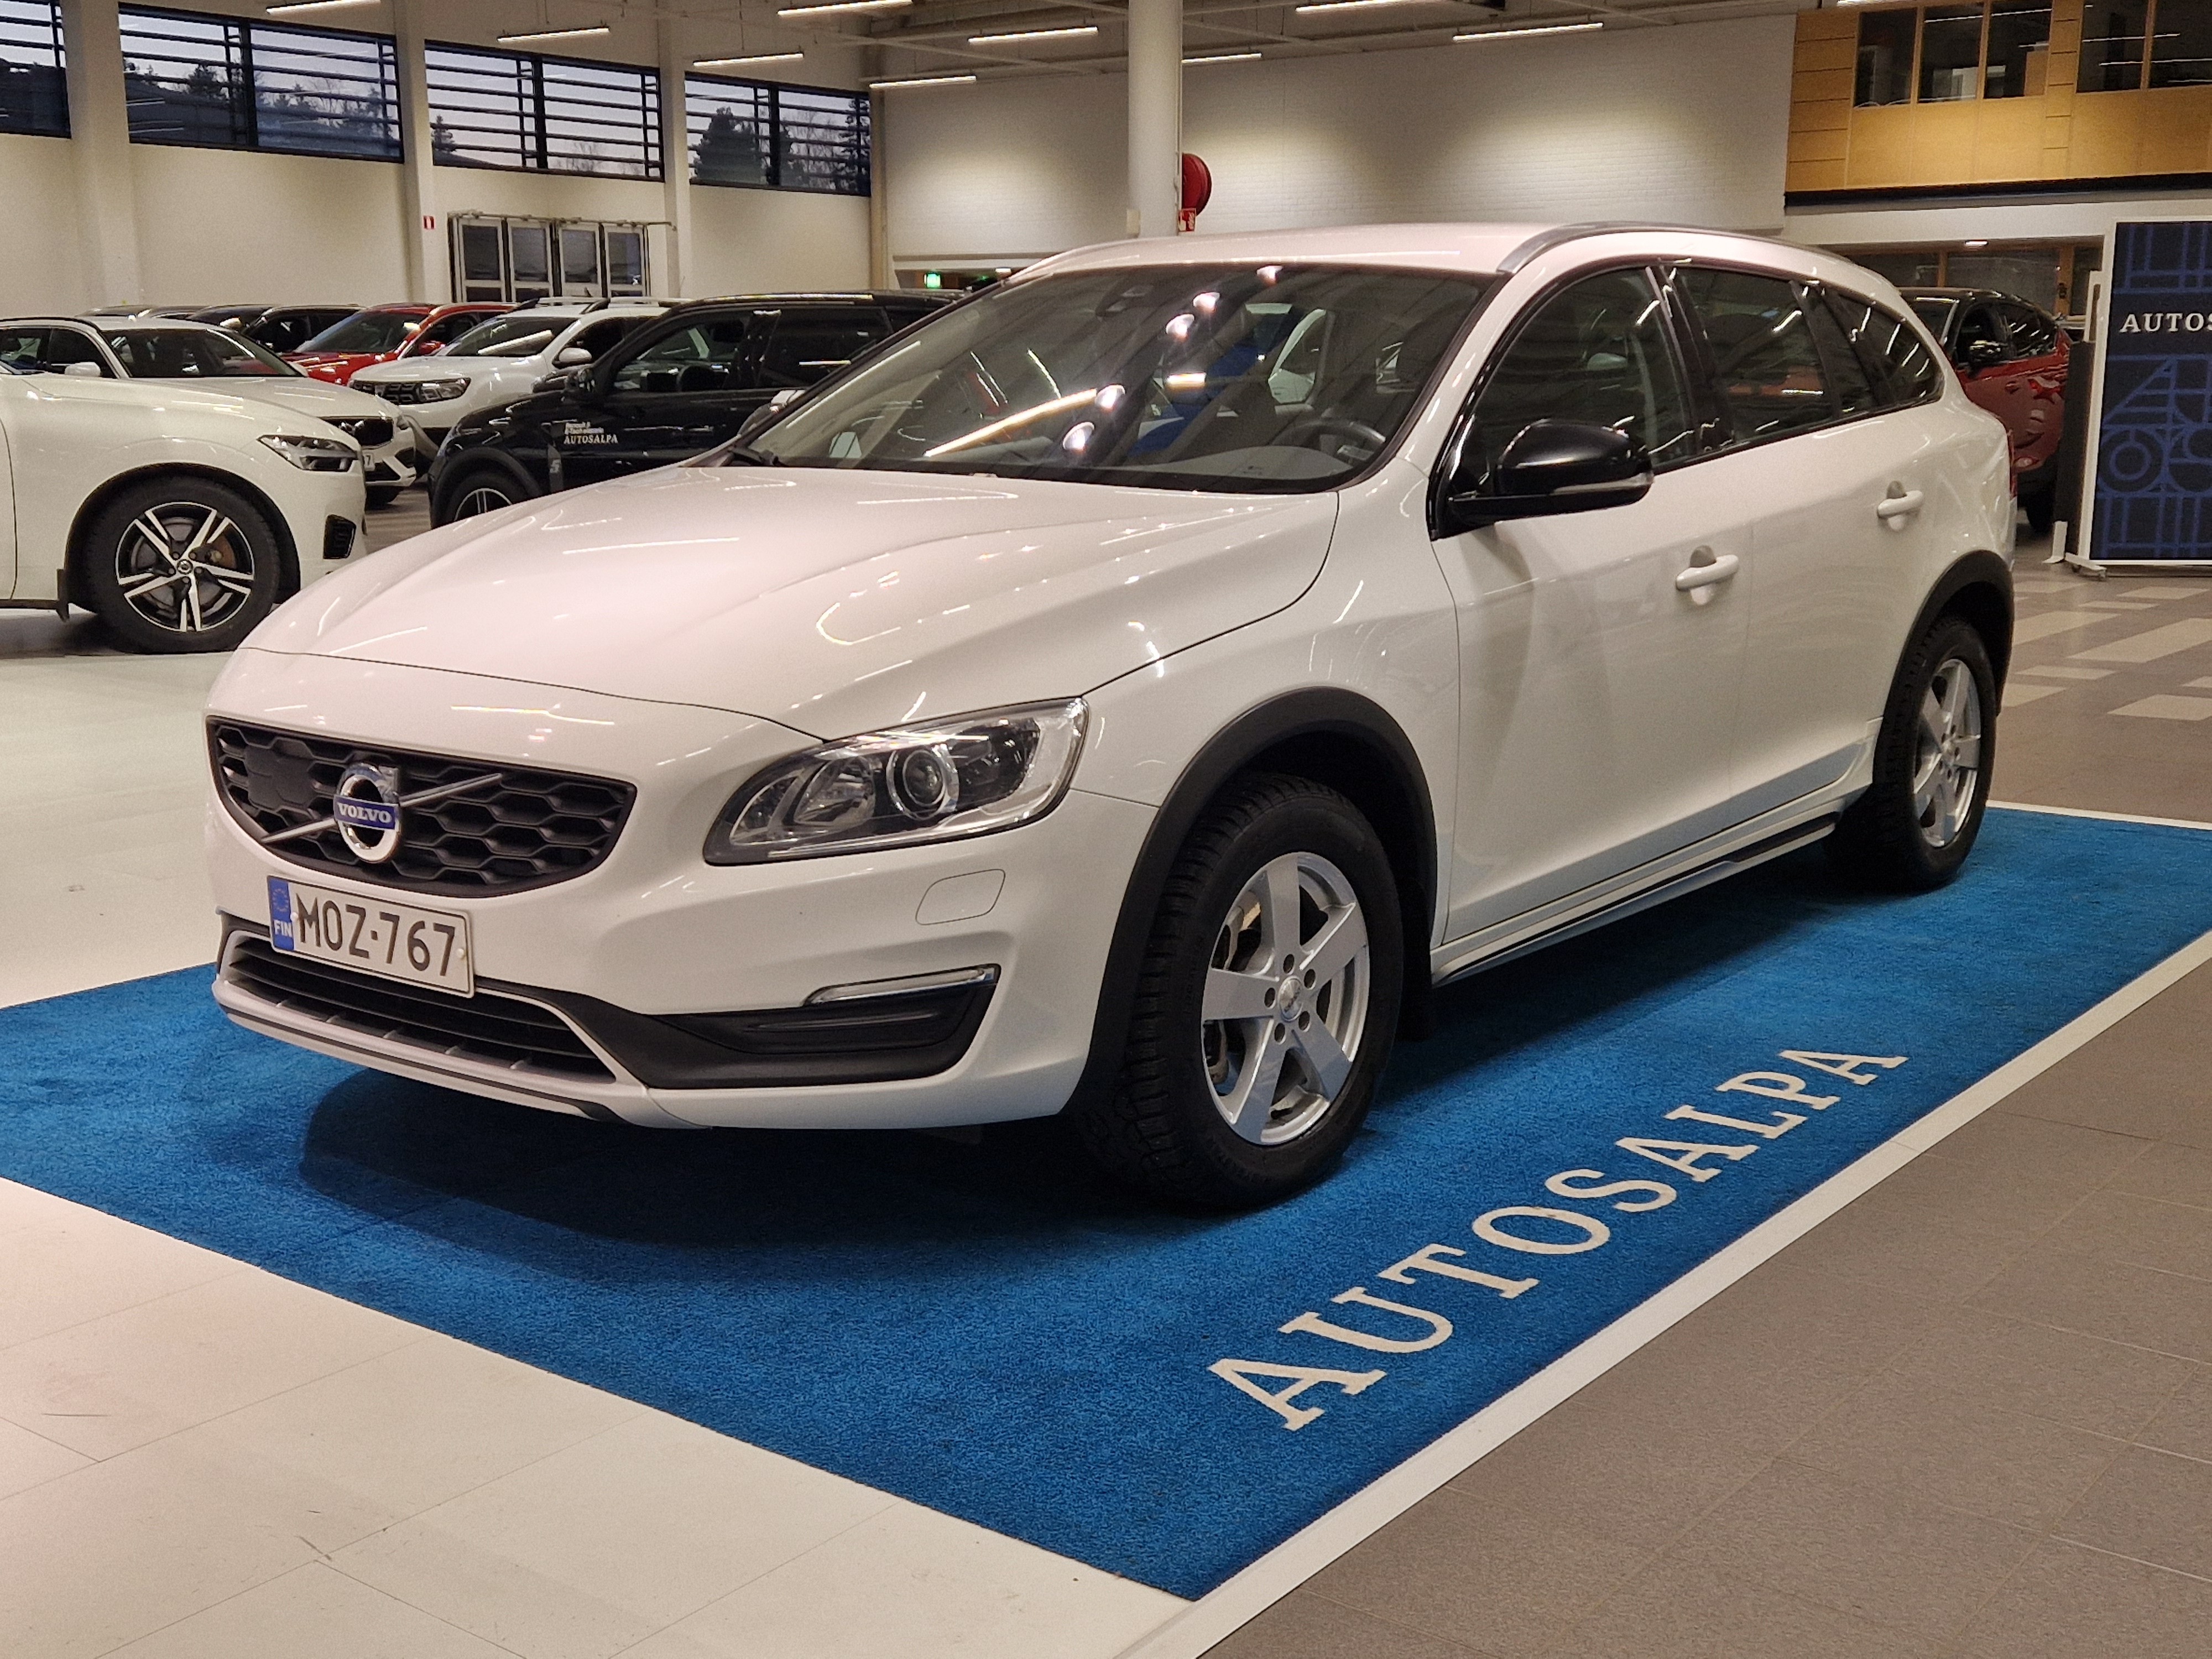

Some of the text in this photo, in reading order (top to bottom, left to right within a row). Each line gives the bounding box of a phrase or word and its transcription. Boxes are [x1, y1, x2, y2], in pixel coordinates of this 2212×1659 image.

[564, 434, 618, 444] AUTOSALPA
[337, 803, 392, 823] VOLVO
[274, 920, 293, 937] FIN
[296, 893, 455, 976] MOZ-767
[1208, 1049, 1908, 1431] AUTOSALPA
